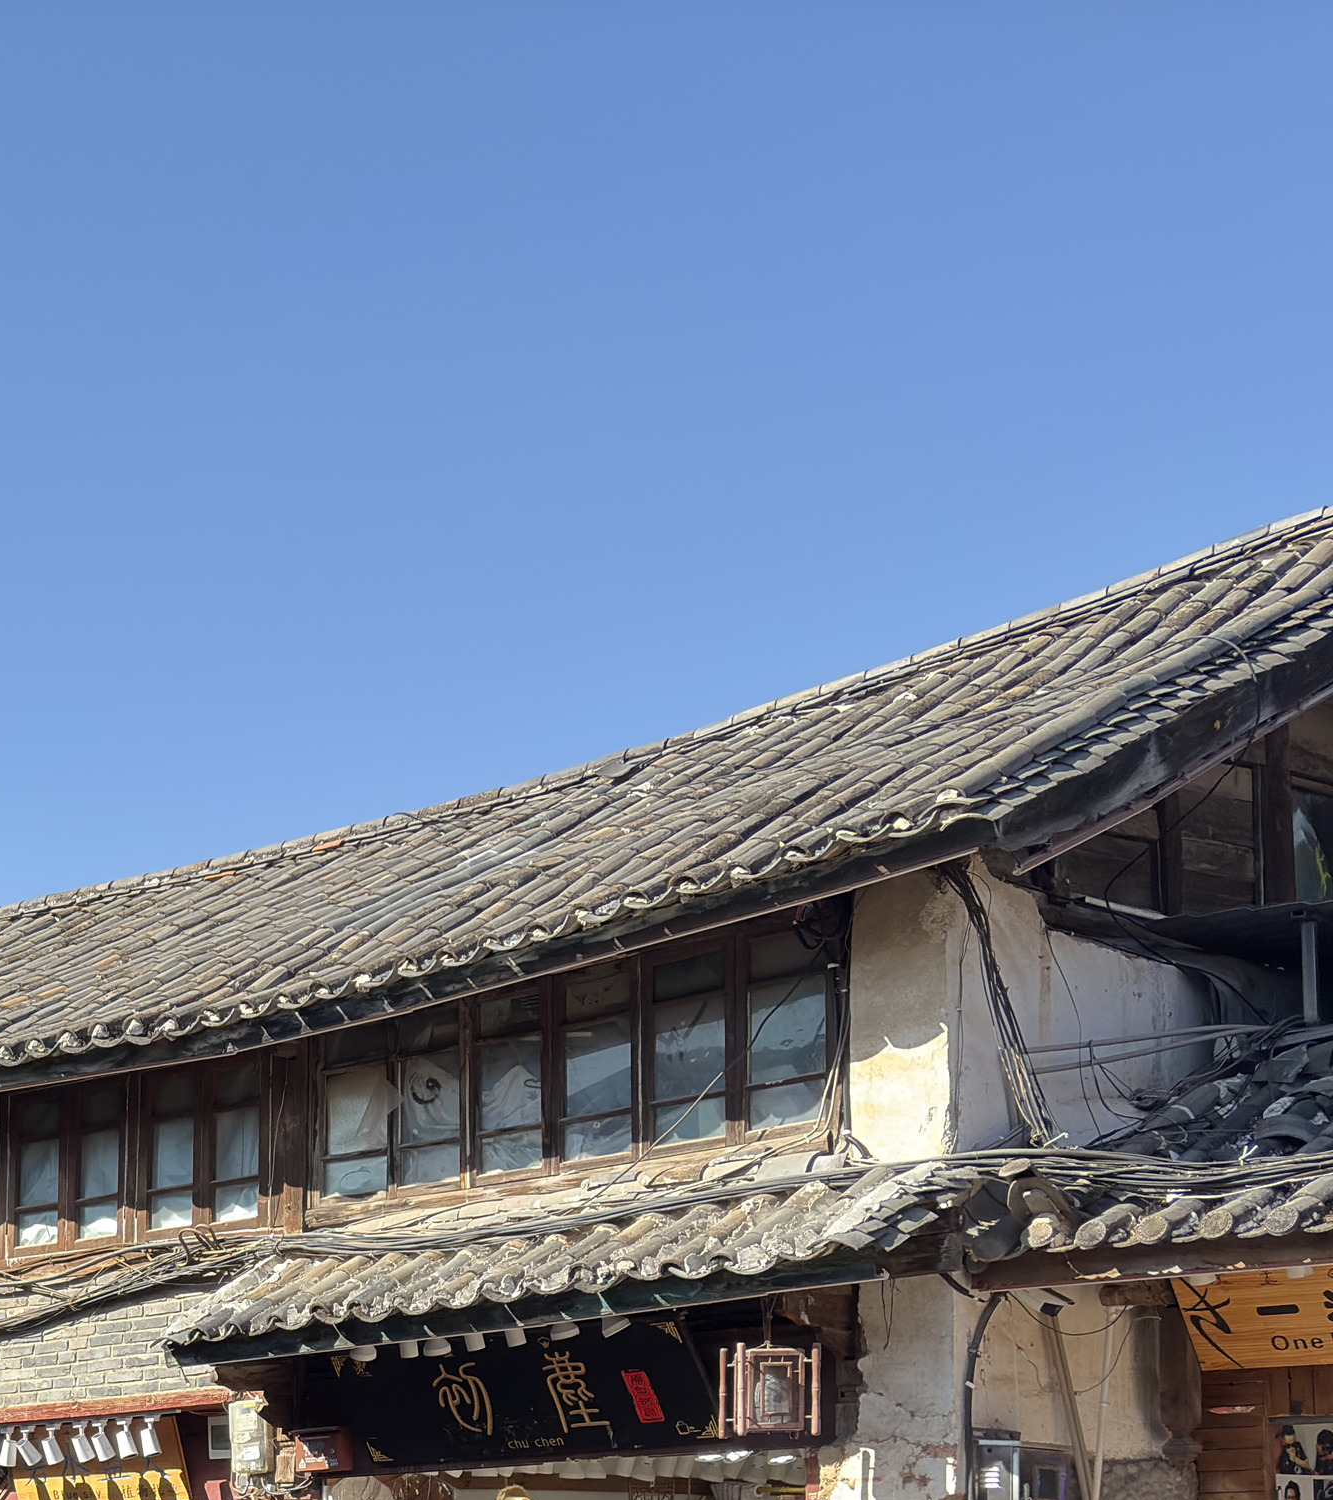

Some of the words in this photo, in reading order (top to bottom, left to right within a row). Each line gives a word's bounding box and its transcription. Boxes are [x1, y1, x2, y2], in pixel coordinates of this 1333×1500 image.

[1271, 1335, 1324, 1350] One
[508, 1439, 529, 1449] chu
[534, 1436, 564, 1448] chen
